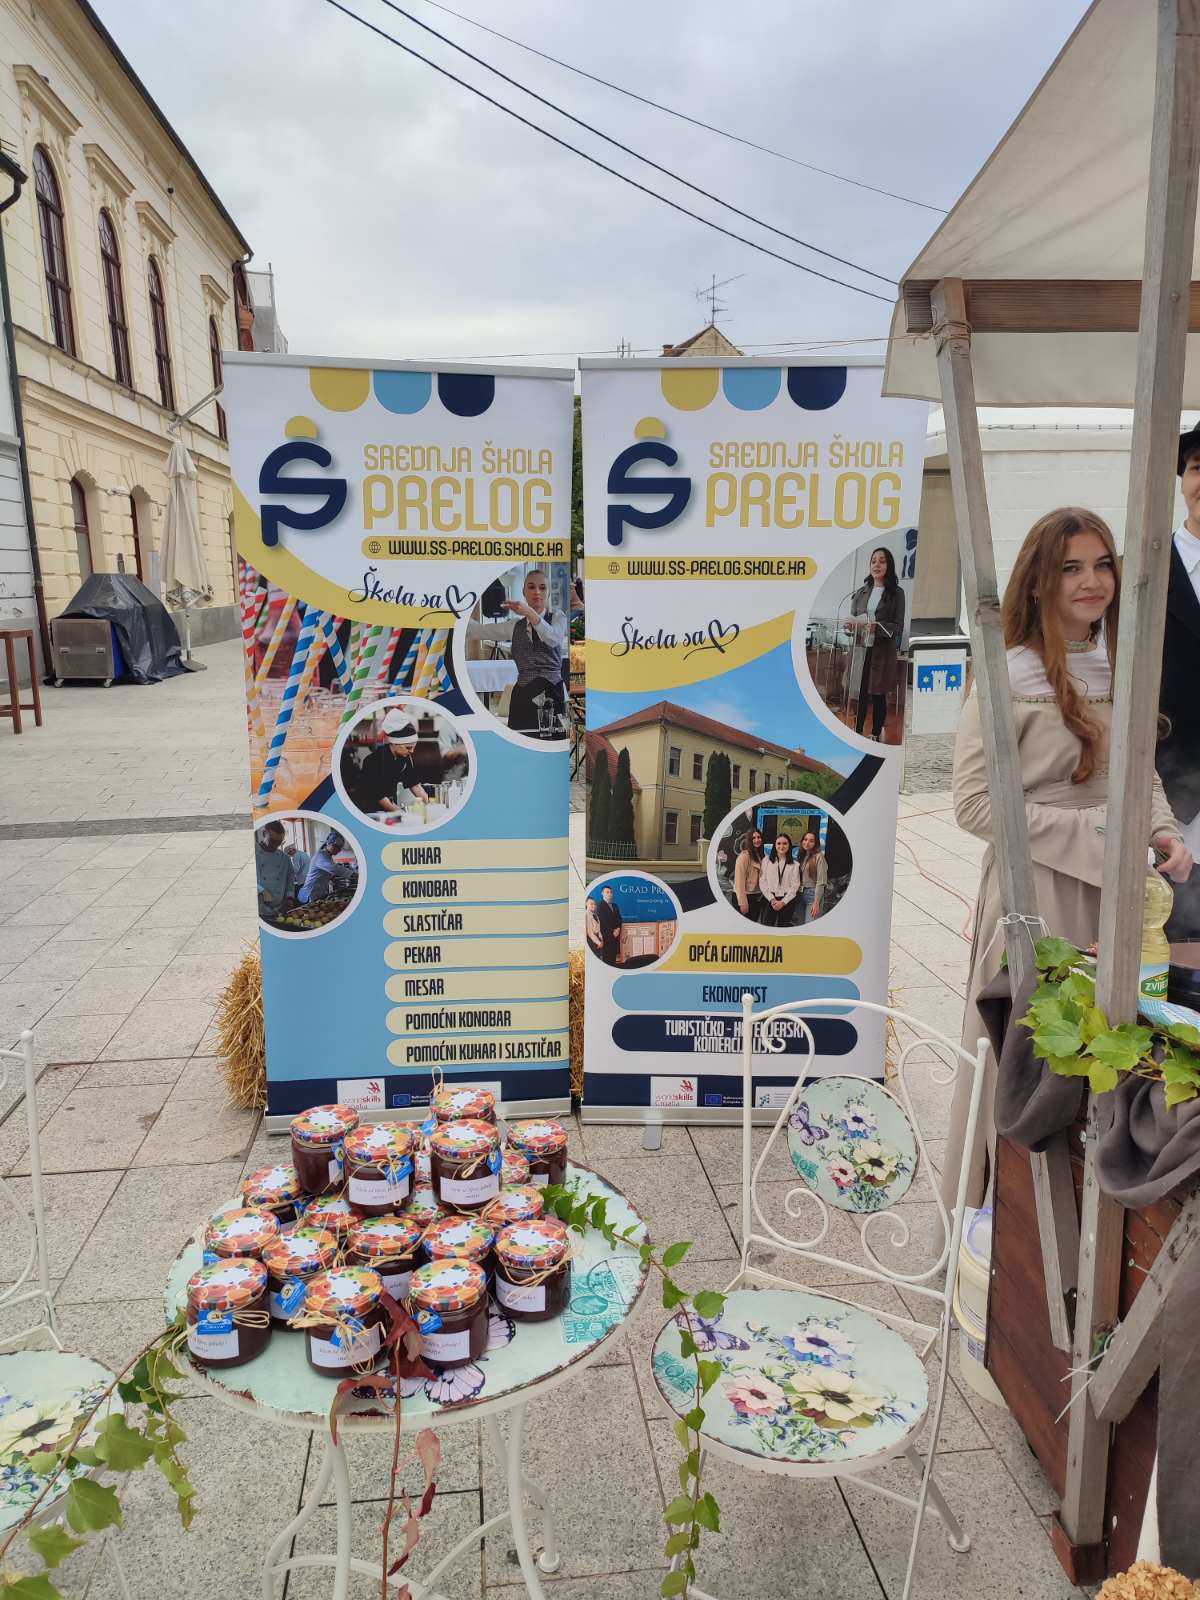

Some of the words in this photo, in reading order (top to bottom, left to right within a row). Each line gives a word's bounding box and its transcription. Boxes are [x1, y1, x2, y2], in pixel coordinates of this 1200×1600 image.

[363, 444, 472, 473] SREDNJA
[481, 441, 553, 475] ŠKOLA
[708, 441, 819, 468] SREDNJA
[828, 434, 904, 468] ŠKOLA
[362, 474, 553, 534] PRELOG
[705, 472, 901, 529] PRELOG
[388, 540, 564, 557] WWW.SS-PRELOG.SKOLE.HR
[627, 560, 806, 576] WWW.SS-PRELOG.SKOLE.HR
[348, 566, 417, 607] Škola
[420, 591, 443, 609] sa
[610, 617, 678, 657] Škola
[682, 630, 706, 648] sa
[401, 846, 442, 865] KUHAR
[402, 879, 458, 898] KONOBAR
[403, 909, 463, 932] SLASTIČAR
[404, 945, 441, 964] PEKAR
[689, 940, 718, 962] OPĆA
[721, 945, 783, 963] GIMNAZIJA
[405, 978, 445, 997] MESAR
[405, 1008, 456, 1030] POMOĆNI
[458, 1010, 511, 1028] KONOBAR
[665, 1016, 724, 1037] TURISTIČKO
[406, 1041, 457, 1062] POMOĆNI
[459, 1043, 496, 1060] KUHAR
[499, 1043, 503, 1059] I
[505, 1037, 561, 1059] SLASTIČAR
